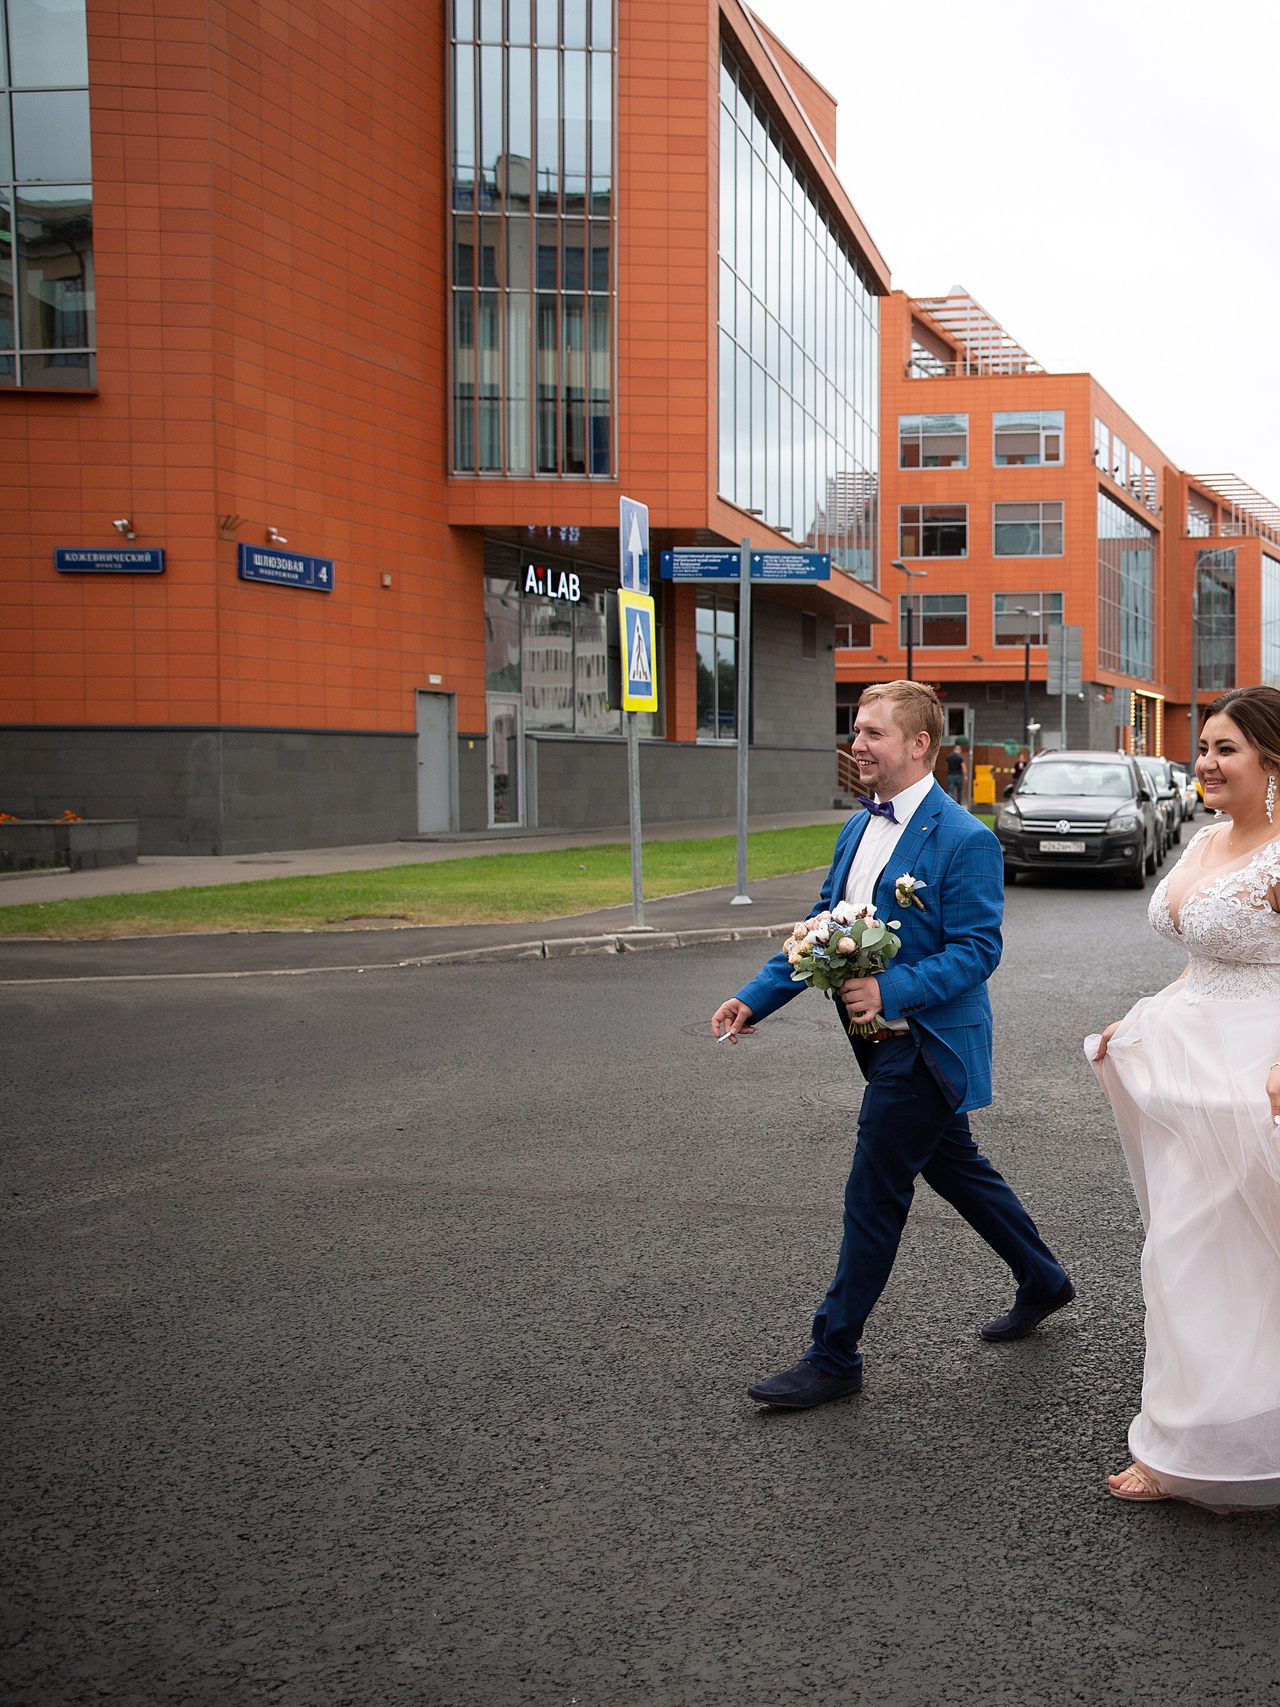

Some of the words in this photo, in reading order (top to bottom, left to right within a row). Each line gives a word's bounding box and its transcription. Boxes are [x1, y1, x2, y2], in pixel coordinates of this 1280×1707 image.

[65, 552, 152, 562] КОЖЕВНИЧЕСКИЙ
[253, 553, 304, 573] ШЛЮЗОВАЯ
[318, 566, 328, 582] 4
[547, 568, 580, 602] LAB
